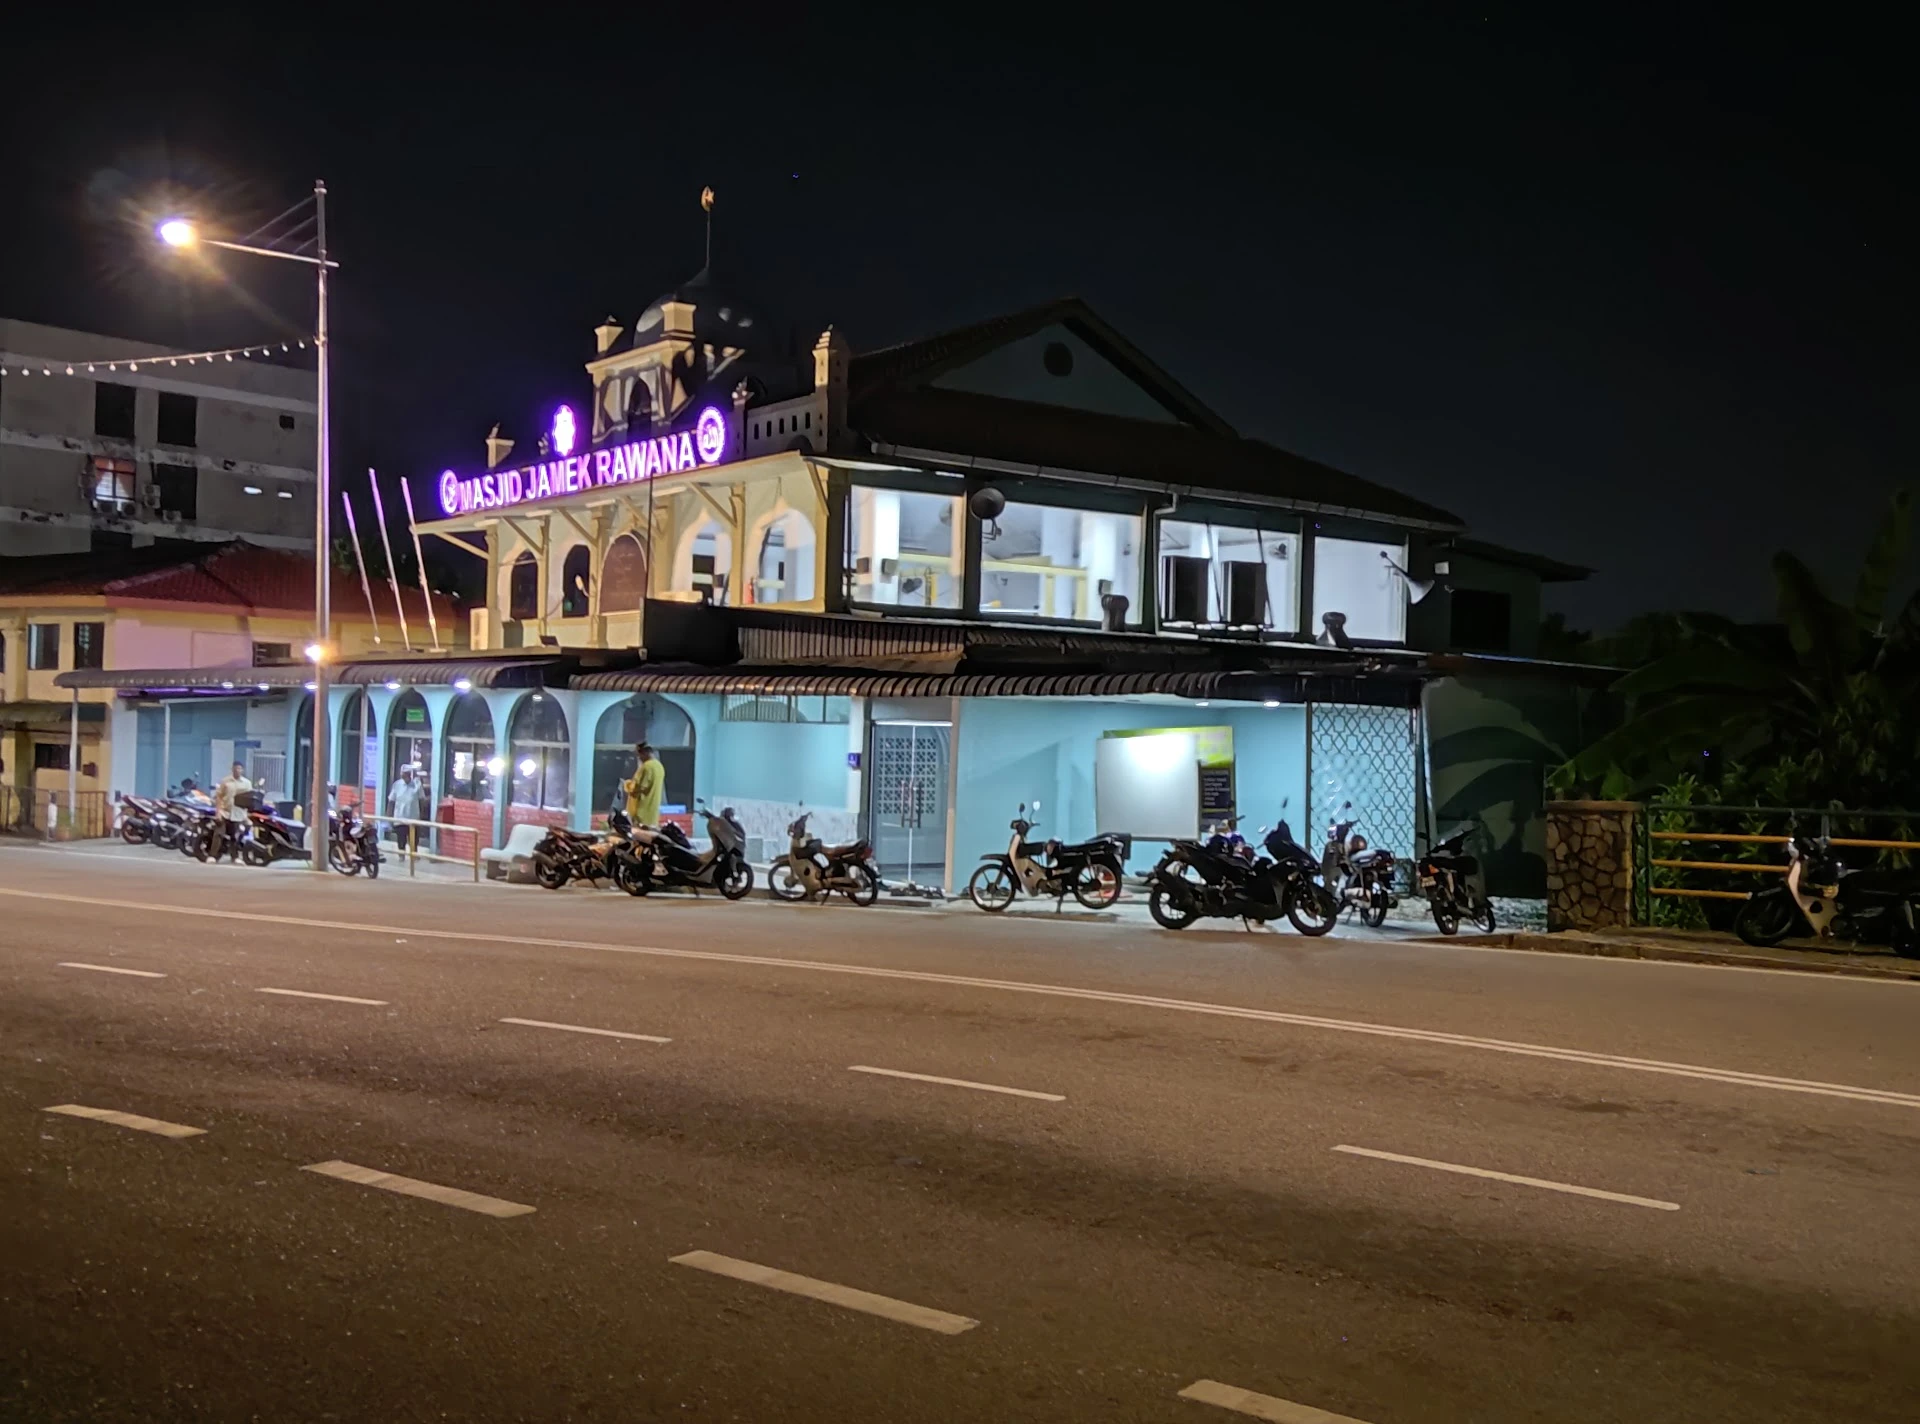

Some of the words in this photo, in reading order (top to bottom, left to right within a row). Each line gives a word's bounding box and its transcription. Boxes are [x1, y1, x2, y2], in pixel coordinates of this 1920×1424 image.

[460, 470, 522, 511] MASJID
[525, 452, 592, 499] JAMEK
[596, 431, 697, 486] RAWANA
